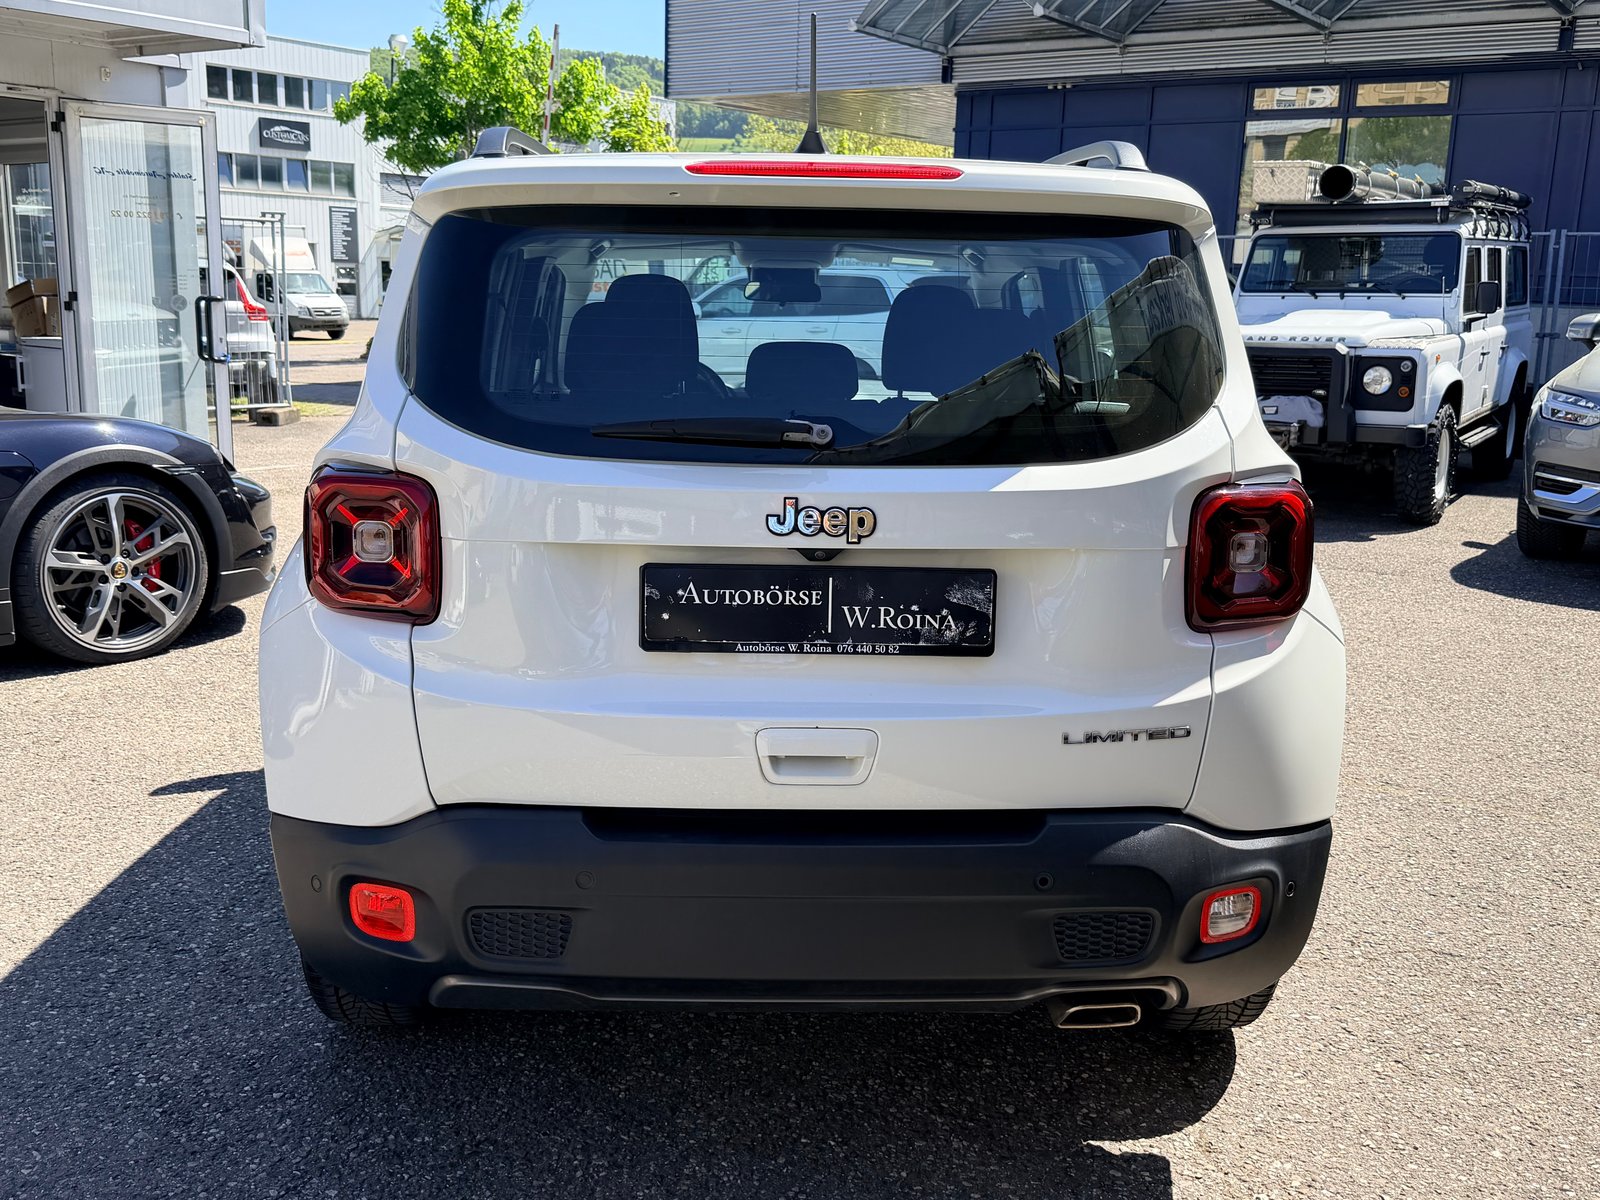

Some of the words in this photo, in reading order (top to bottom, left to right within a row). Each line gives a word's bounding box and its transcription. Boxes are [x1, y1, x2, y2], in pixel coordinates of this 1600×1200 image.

[766, 497, 877, 544] Jeep
[735, 643, 786, 653] Autobörse
[788, 644, 801, 653] W.
[803, 644, 832, 653] Roina
[837, 645, 854, 654] 076
[856, 645, 873, 654] 440
[874, 645, 886, 654] 50
[888, 645, 900, 654] 82
[1062, 726, 1192, 745] LIMITED
